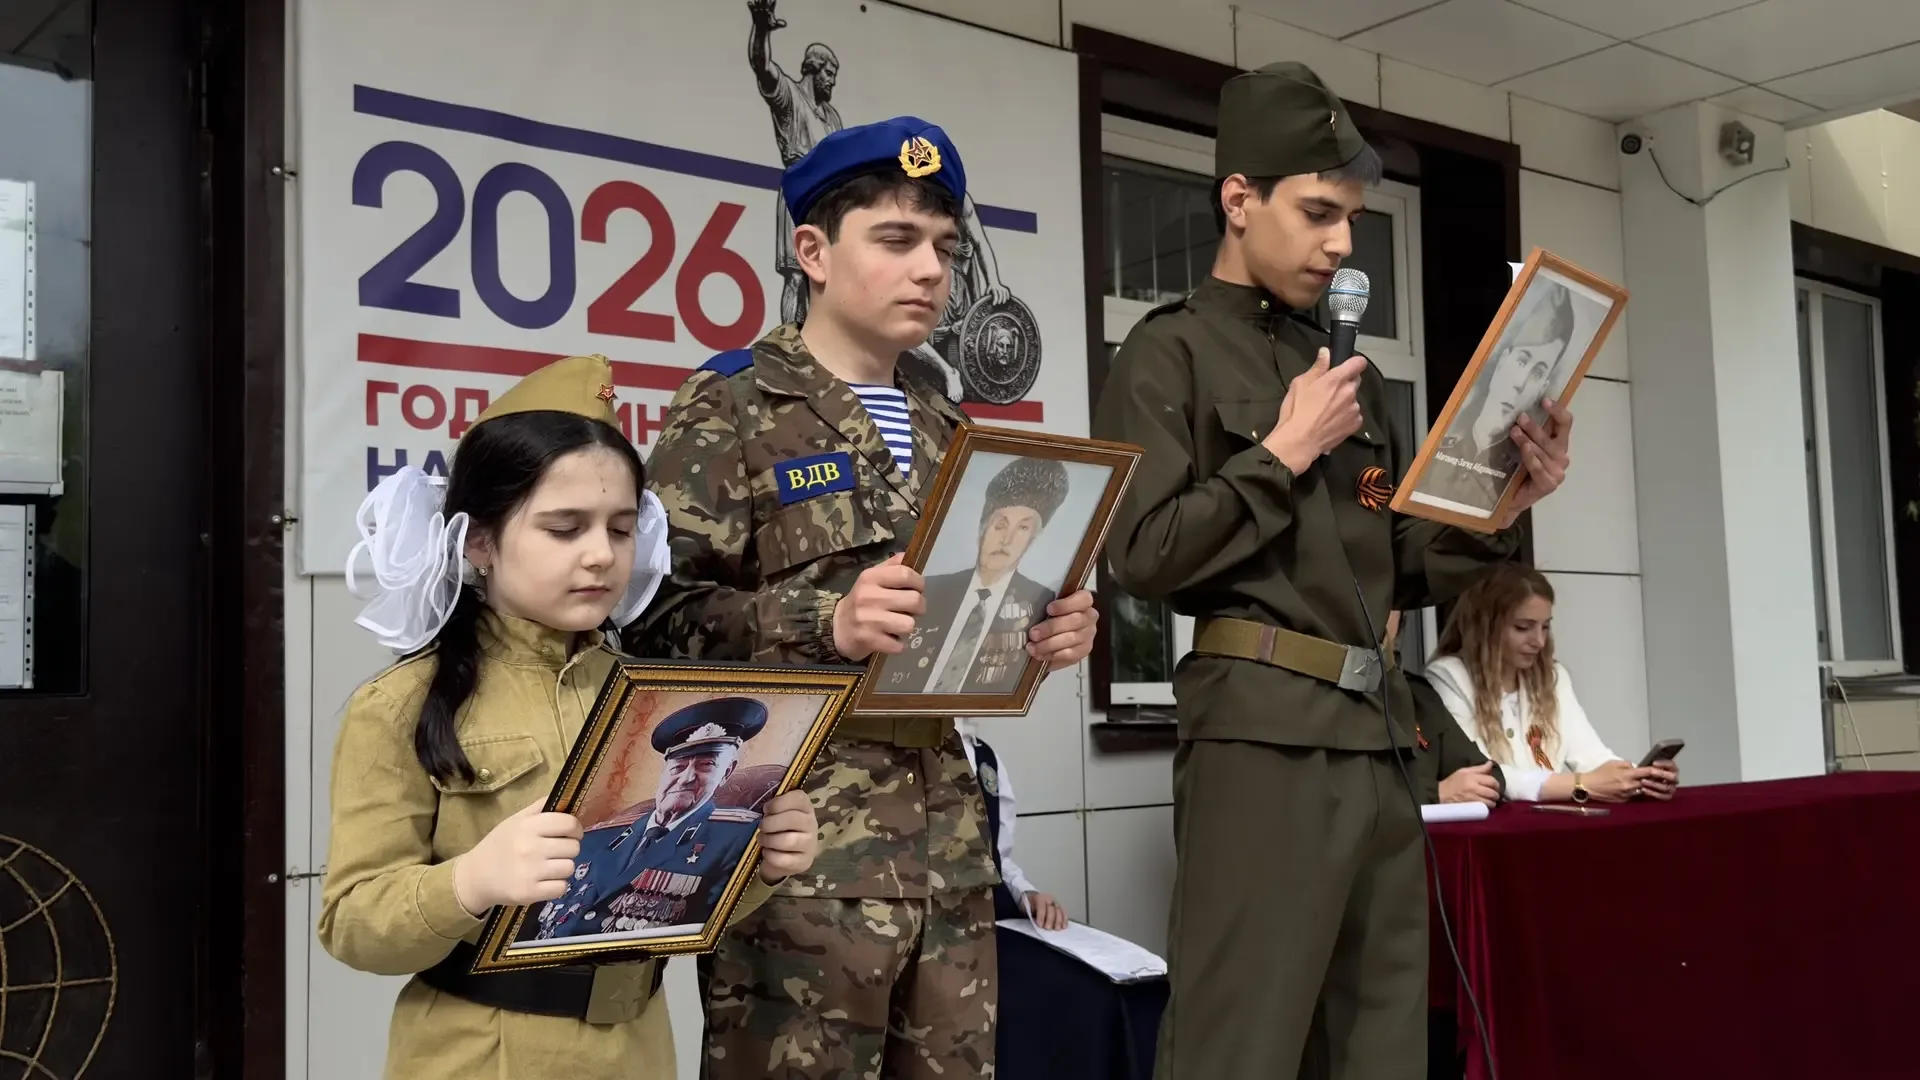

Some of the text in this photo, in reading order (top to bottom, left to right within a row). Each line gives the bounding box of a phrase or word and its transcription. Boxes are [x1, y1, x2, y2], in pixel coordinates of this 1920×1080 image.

[352, 140, 766, 351] 2026
[366, 379, 490, 440] ГОД
[786, 462, 841, 491] ВДВ
